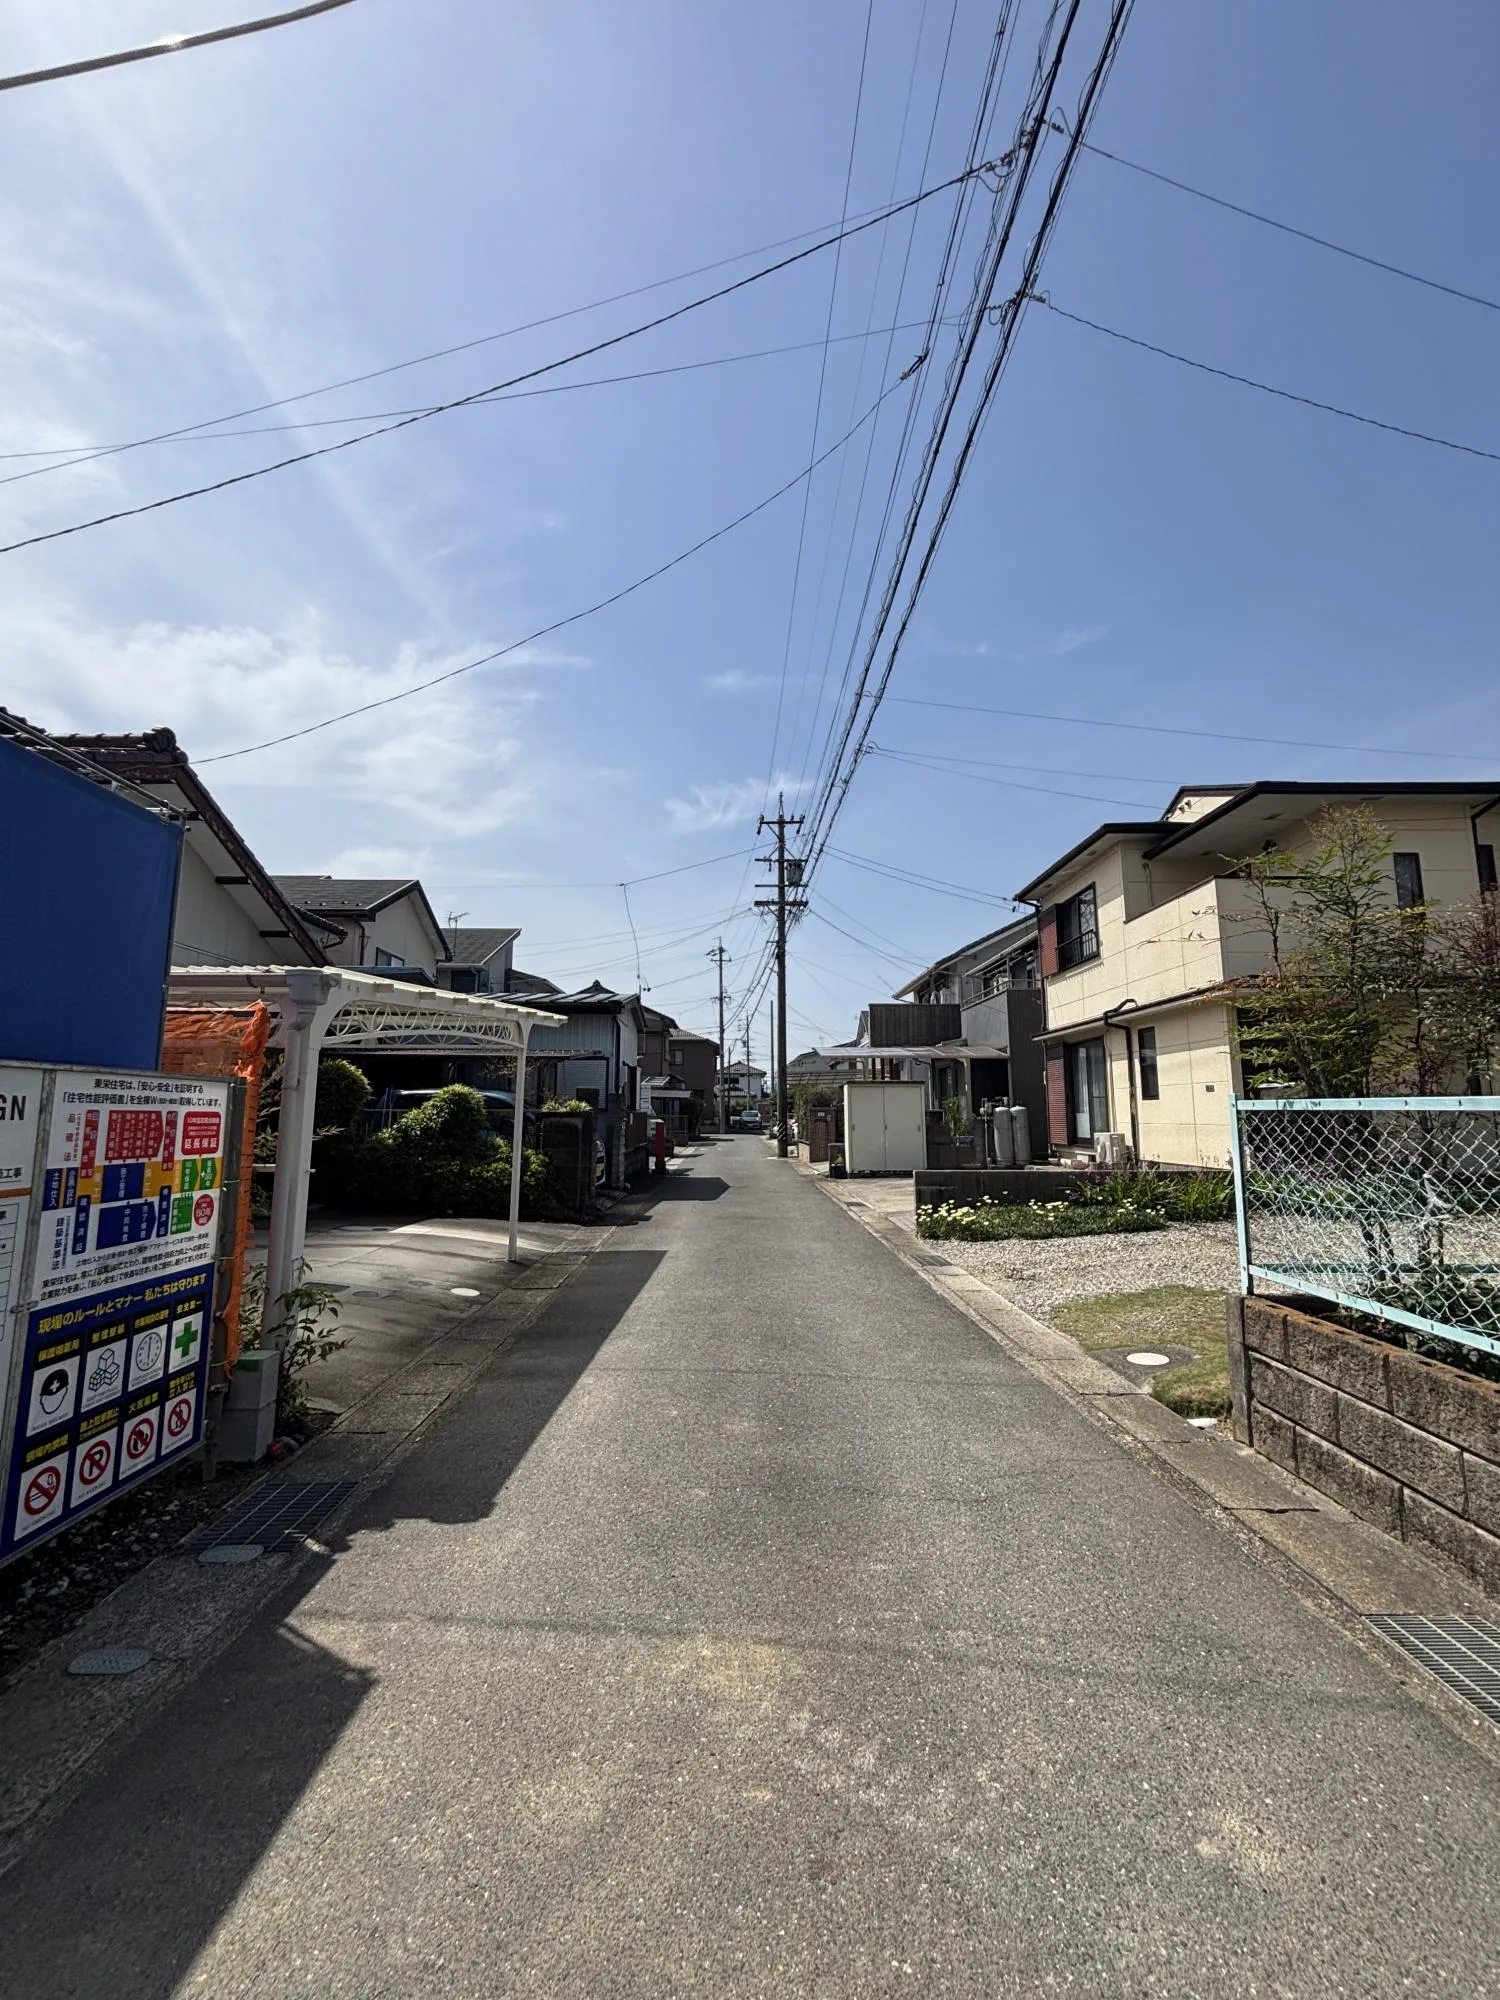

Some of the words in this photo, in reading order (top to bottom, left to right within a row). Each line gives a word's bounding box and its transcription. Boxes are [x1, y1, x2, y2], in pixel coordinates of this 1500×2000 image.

[184, 1138, 217, 1149] 延長保証
[48, 1171, 60, 1207] 土地仕入
[37, 1293, 143, 1334] 現場のルールとマナー
[144, 1273, 207, 1301] 私たちは守ります
[176, 1299, 202, 1314] 安全第一
